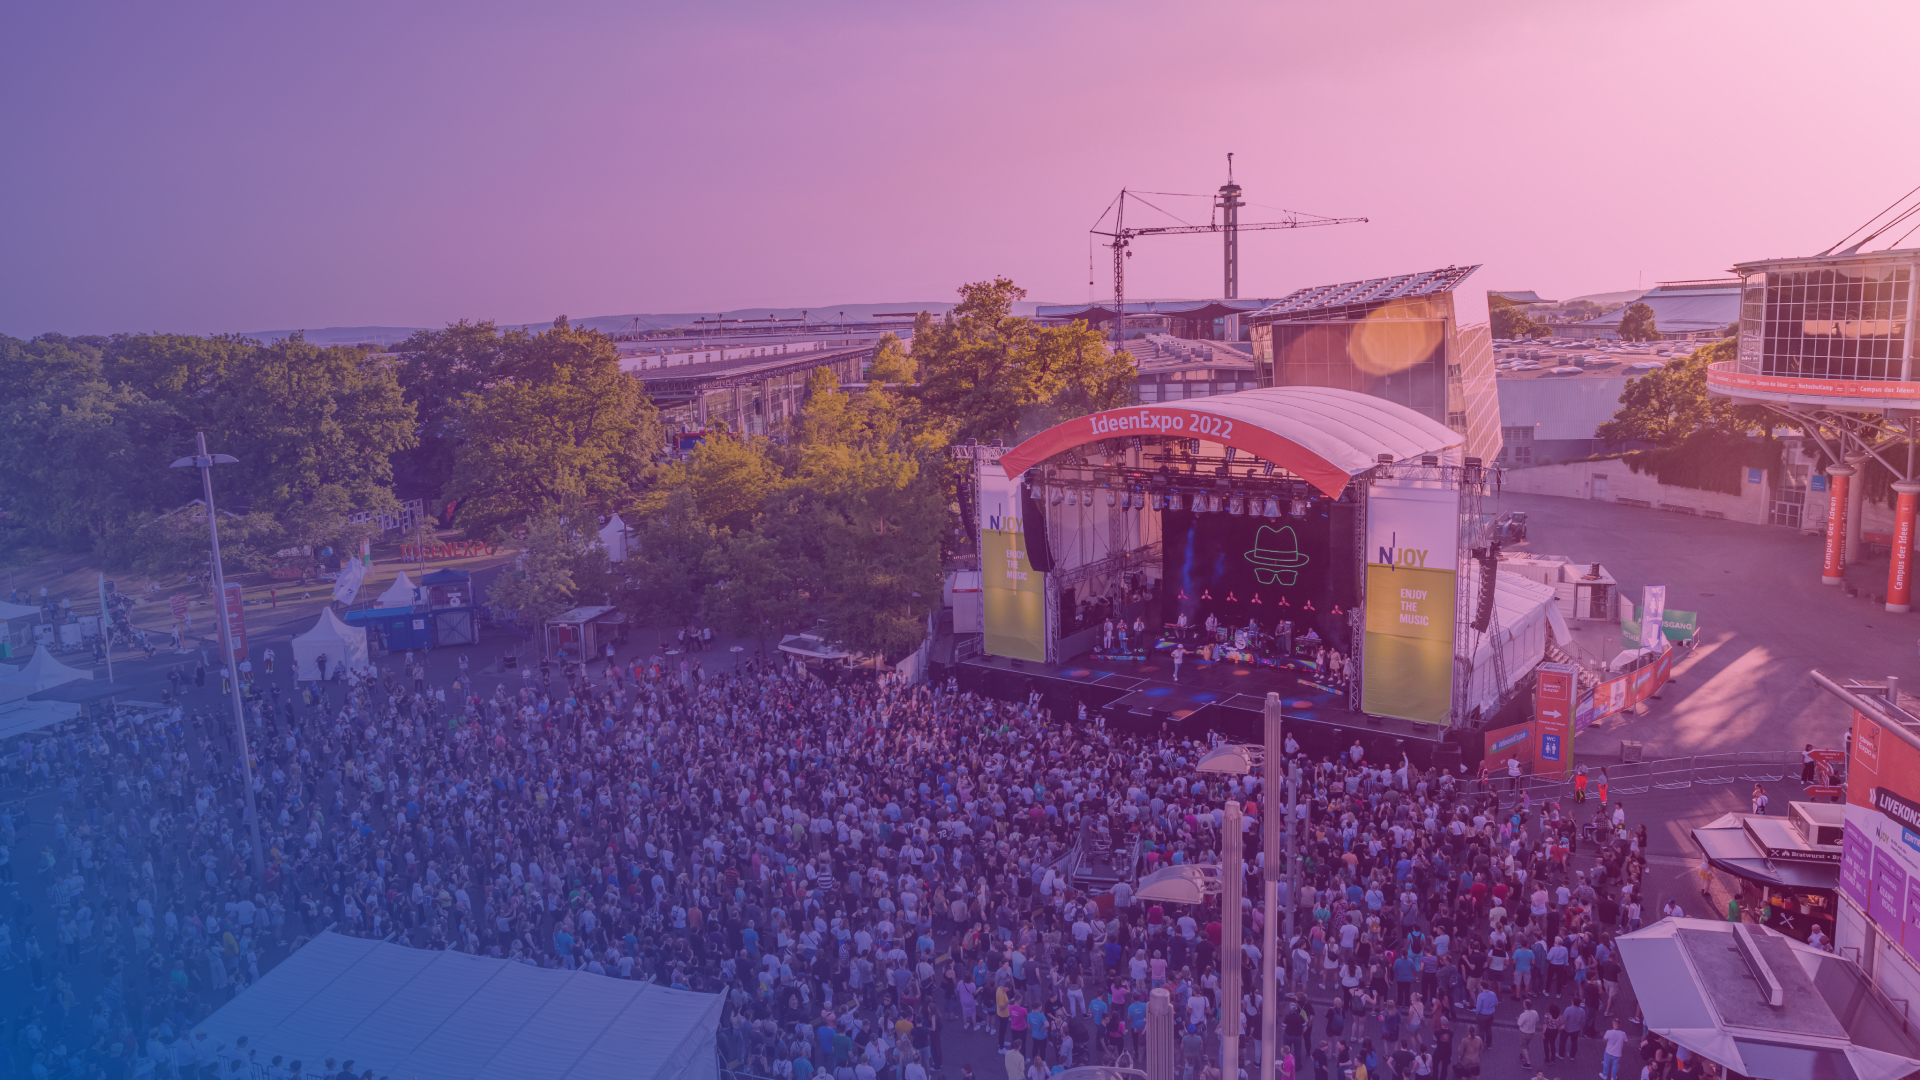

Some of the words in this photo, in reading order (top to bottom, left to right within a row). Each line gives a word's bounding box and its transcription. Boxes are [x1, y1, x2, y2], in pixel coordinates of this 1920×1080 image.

[1860, 386, 1882, 394] Campus
[1897, 386, 1915, 394] Ideen
[1089, 410, 1184, 436] IdeenExpo
[1188, 413, 1233, 439] 2022
[1828, 496, 1837, 520] Ideen
[1827, 522, 1836, 537] der
[1898, 521, 1909, 545] Ideen
[1006, 549, 1025, 559] ENJOY
[1824, 537, 1834, 570] Campus
[1897, 544, 1906, 559] der
[1006, 559, 1019, 569] THE
[1006, 570, 1027, 581] MUSIC
[1894, 559, 1905, 590] Campus
[1400, 588, 1427, 601] ENJOY
[1400, 600, 1417, 612] THE
[1399, 613, 1430, 626] MUSIC
[1498, 732, 1526, 748] IdeenExpo
[937, 829, 947, 839] 72
[1791, 851, 1825, 860] Bratwurst
[1879, 886, 1894, 905] GIANT
[1881, 898, 1897, 918] ROOKS
